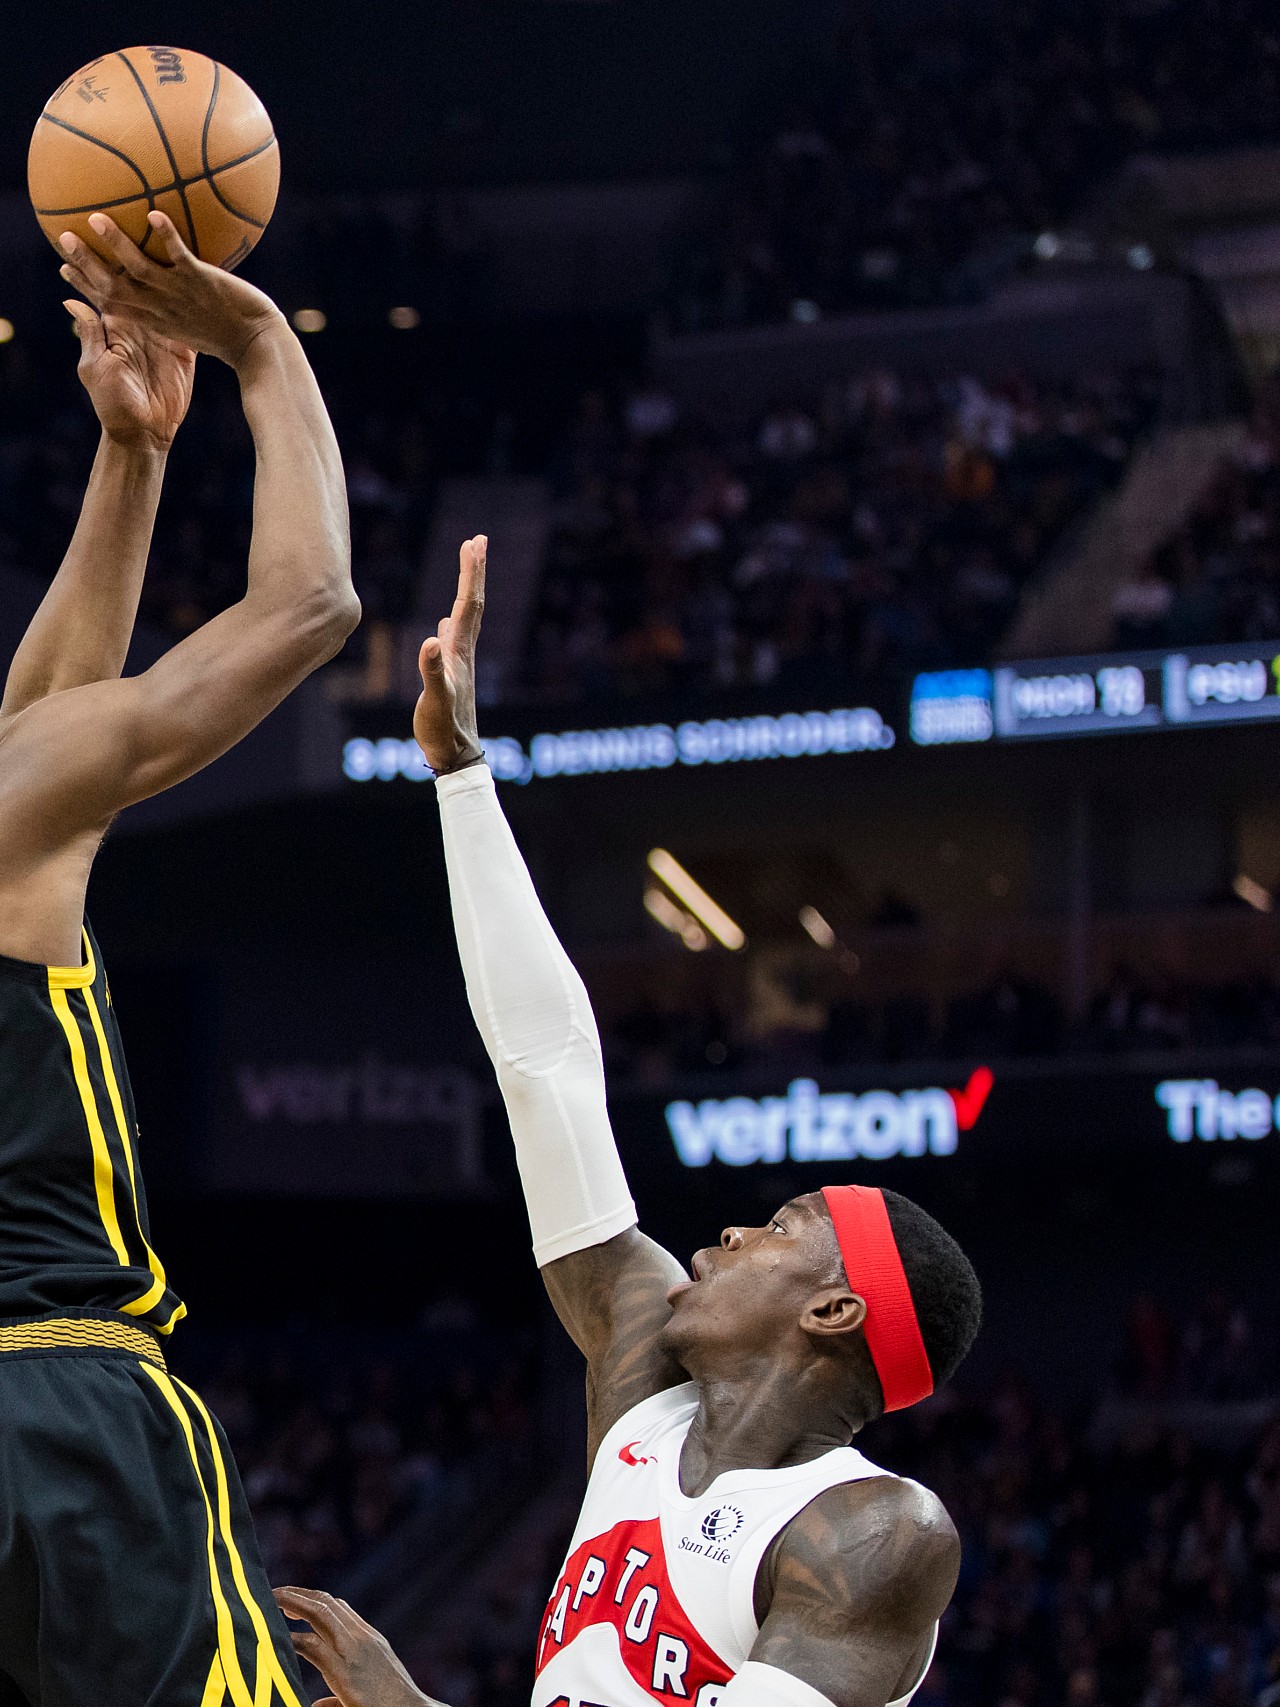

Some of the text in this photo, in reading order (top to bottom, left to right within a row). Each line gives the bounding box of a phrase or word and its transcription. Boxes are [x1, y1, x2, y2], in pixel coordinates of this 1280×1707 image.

[1187, 659, 1267, 705] PSU
[665, 1077, 959, 1168] verizon
[1154, 1078, 1272, 1142] The
[678, 1536, 731, 1564] Sun Life
